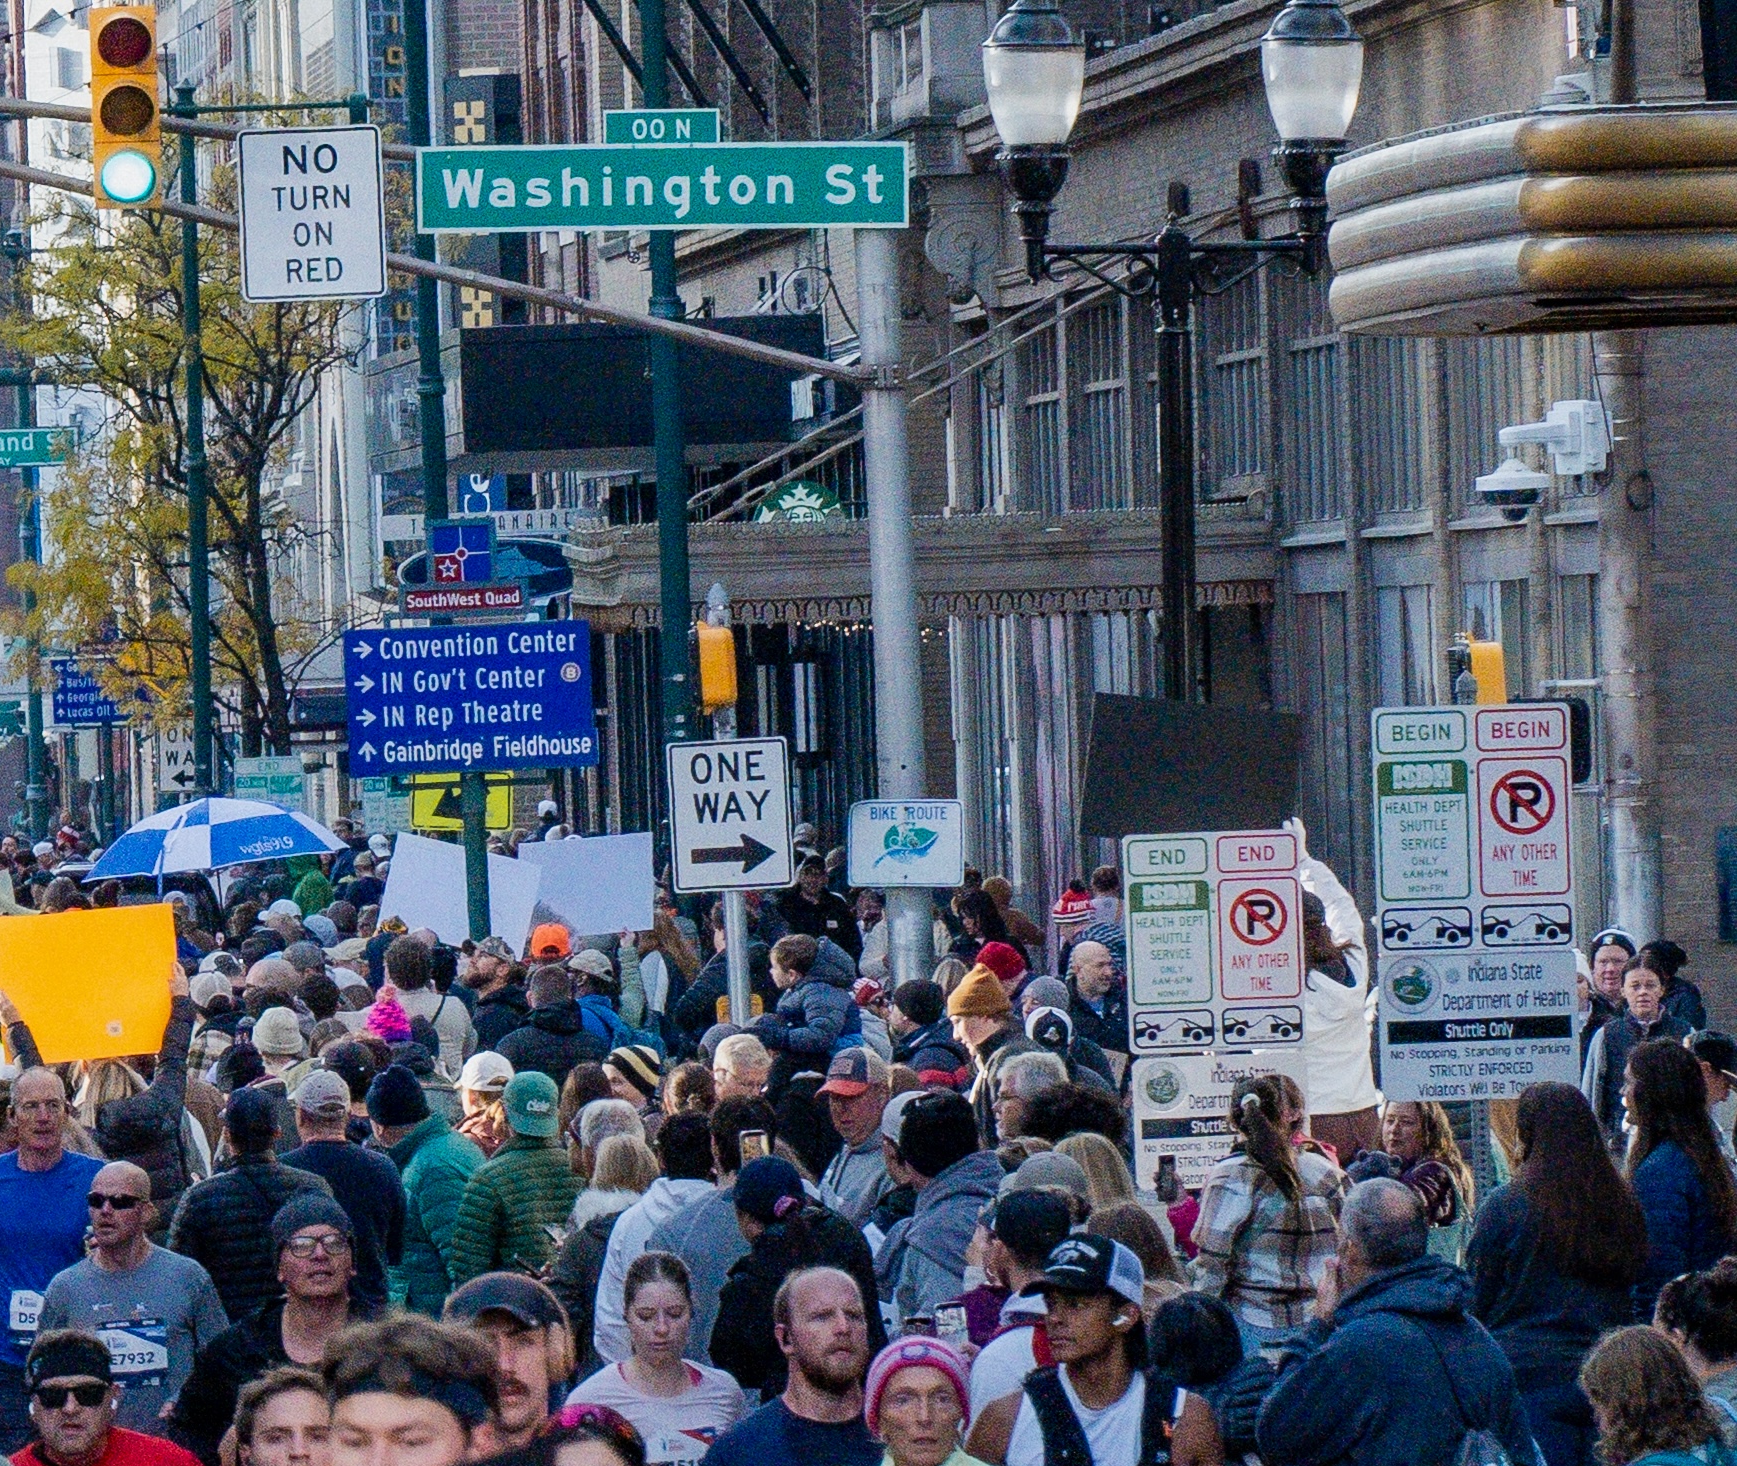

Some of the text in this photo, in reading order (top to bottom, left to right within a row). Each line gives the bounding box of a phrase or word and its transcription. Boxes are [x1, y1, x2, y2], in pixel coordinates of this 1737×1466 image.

[675, 119, 692, 139] N
[282, 145, 338, 175] NO
[272, 185, 352, 210] TURN
[441, 163, 884, 218] Washington St
[293, 223, 333, 247] ON
[286, 258, 344, 284] RED
[406, 590, 521, 608] SouthWest Quad
[379, 630, 577, 660] Convention Center
[382, 671, 403, 694] IN
[413, 669, 467, 692] Gov't
[475, 667, 546, 690] Center
[383, 701, 543, 731] IN Rep Theatre
[1392, 721, 1550, 743] BEGIN BEGIN
[165, 750, 195, 766] WA
[383, 734, 592, 766] Gainbridge Fieldhouse
[690, 750, 766, 785] ONE
[693, 789, 771, 824] WAY
[870, 805, 948, 821] BIKE ROUTE
[1384, 800, 1462, 815] HEALTH DEPT
[1399, 819, 1448, 832] SHUTTLE
[1401, 837, 1448, 850] SERVICE
[1492, 843, 1558, 862] ANY OTHER
[1148, 845, 1276, 866] END END
[1512, 870, 1538, 887] TIME
[1136, 915, 1204, 929] HEALTH DEPT
[1149, 932, 1192, 944] SHUTTLE
[1150, 949, 1192, 961] SERVICE
[1231, 953, 1290, 970] ANY OTHER
[1467, 962, 1543, 982] Indiana State
[1250, 976, 1273, 991] TIME
[1442, 989, 1571, 1011] Department of Health
[1444, 1022, 1514, 1039] Shuttle Only
[1390, 1050, 1405, 1060] No
[1465, 1046, 1512, 1059] Standing
[1530, 1044, 1571, 1056] Parking
[1429, 1061, 1534, 1078] STRICTLY ENFORCED
[1417, 1082, 1466, 1097] Violators
[1492, 1081, 1506, 1094] Be
[1188, 1093, 1232, 1110] Departm
[1190, 1119, 1227, 1134] Shuttle
